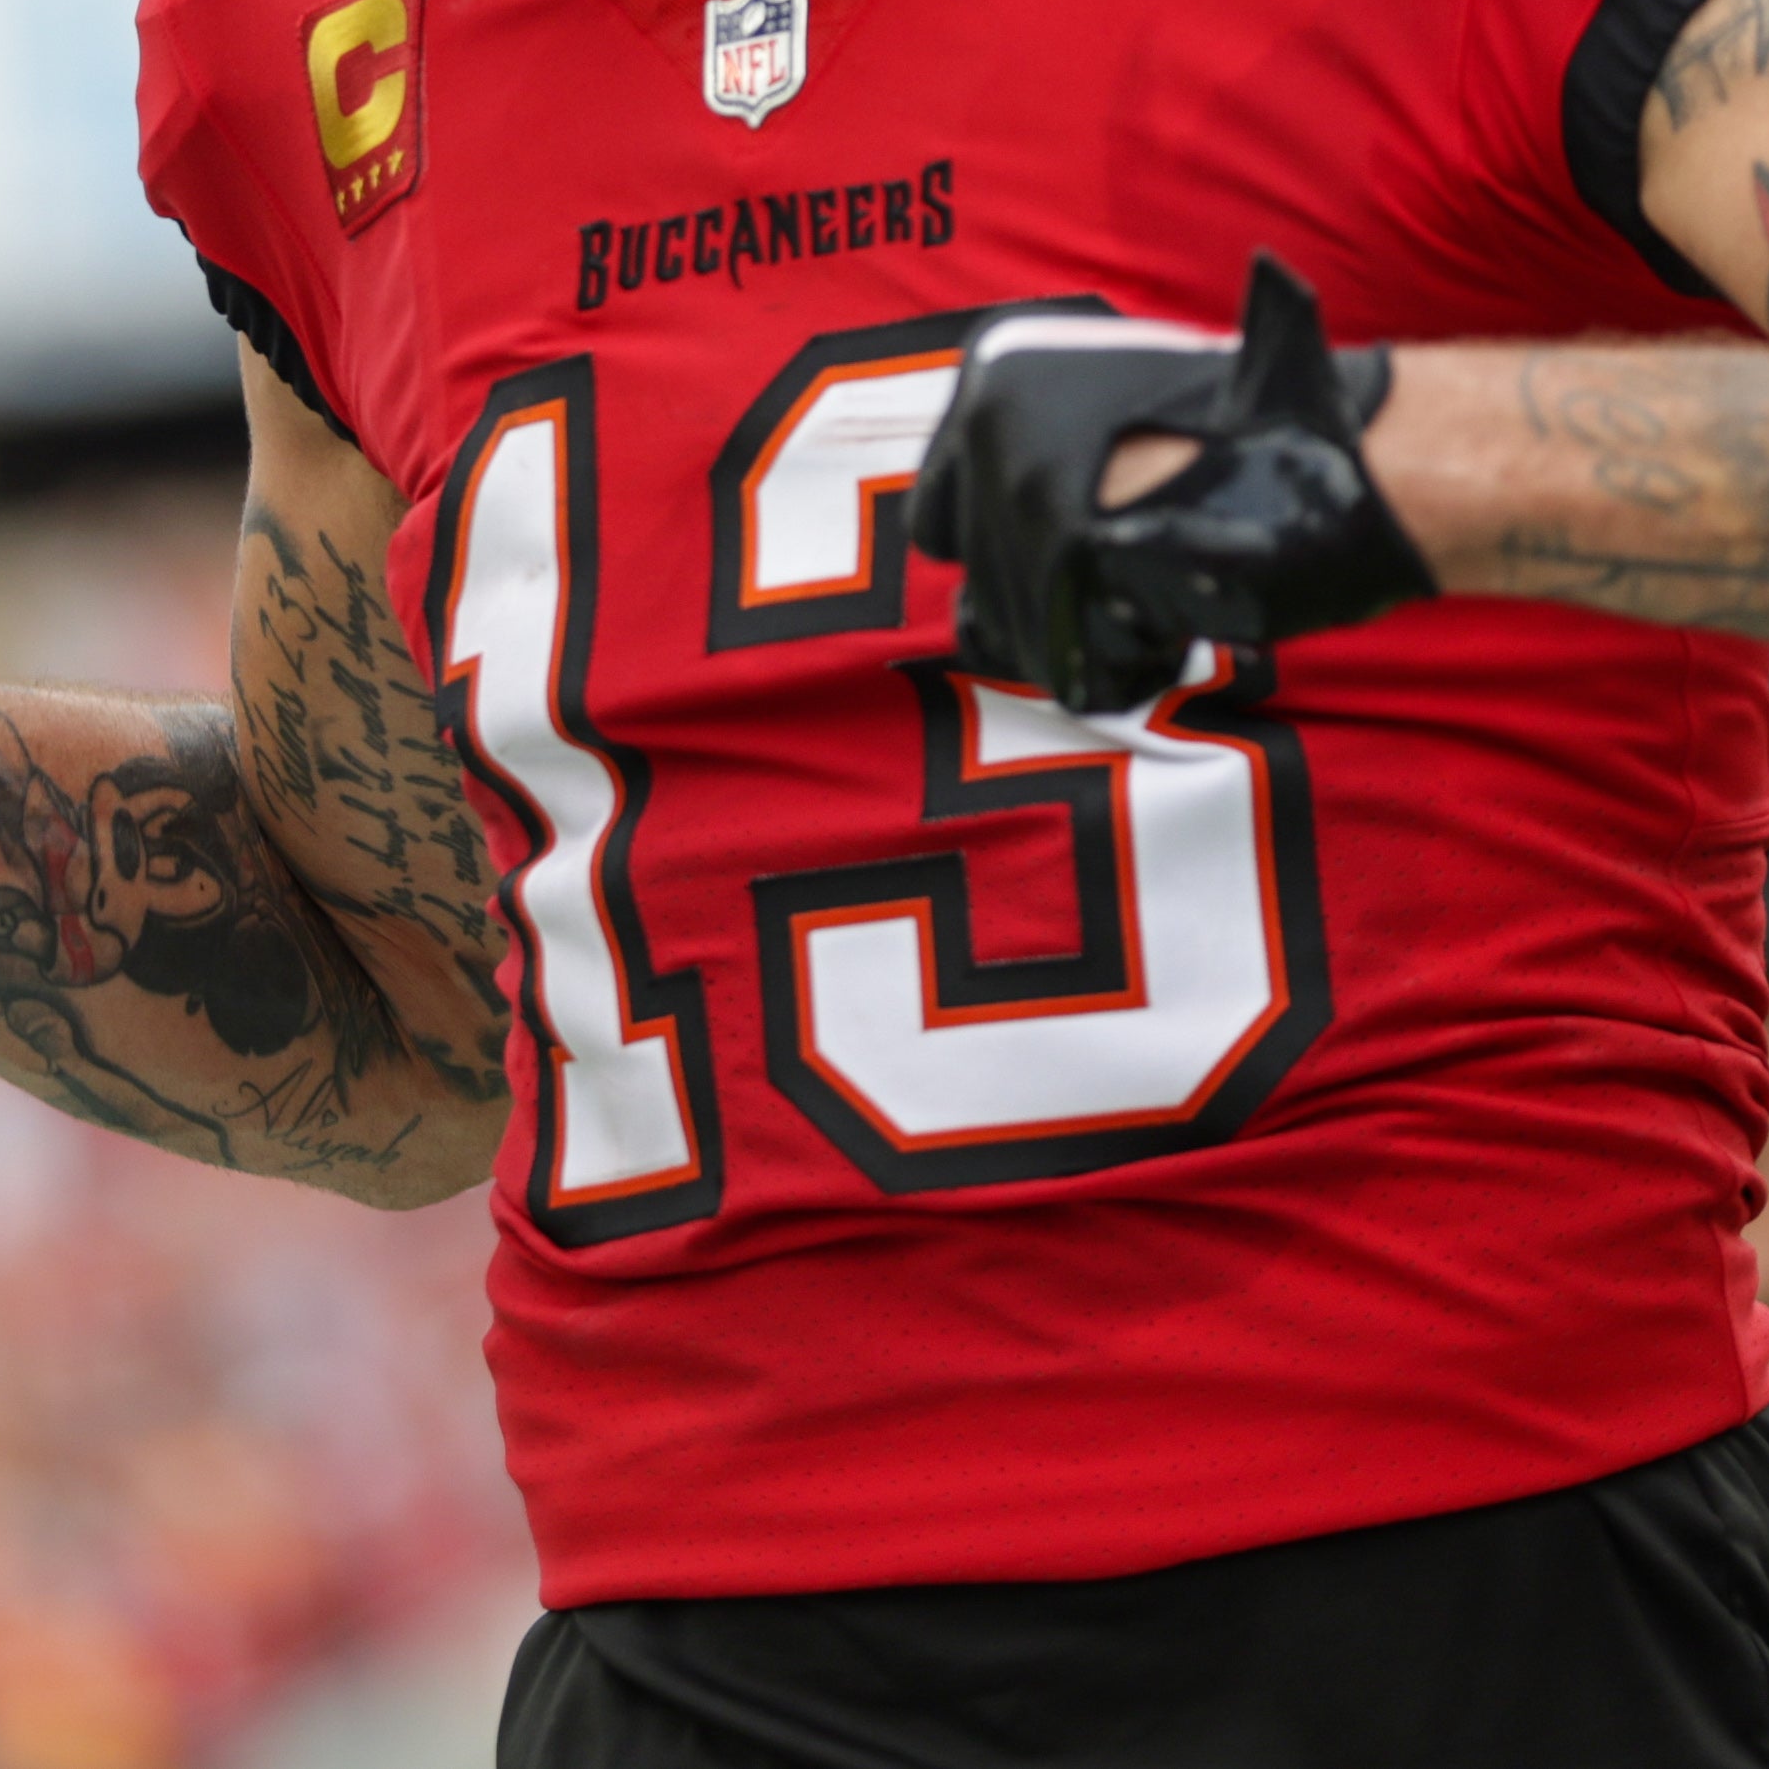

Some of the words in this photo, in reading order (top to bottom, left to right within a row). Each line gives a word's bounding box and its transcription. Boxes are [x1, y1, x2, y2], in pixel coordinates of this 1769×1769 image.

[722, 39, 787, 97] NFL
[577, 158, 954, 312] BUCCANEERS
[424, 294, 1335, 1249] 13
